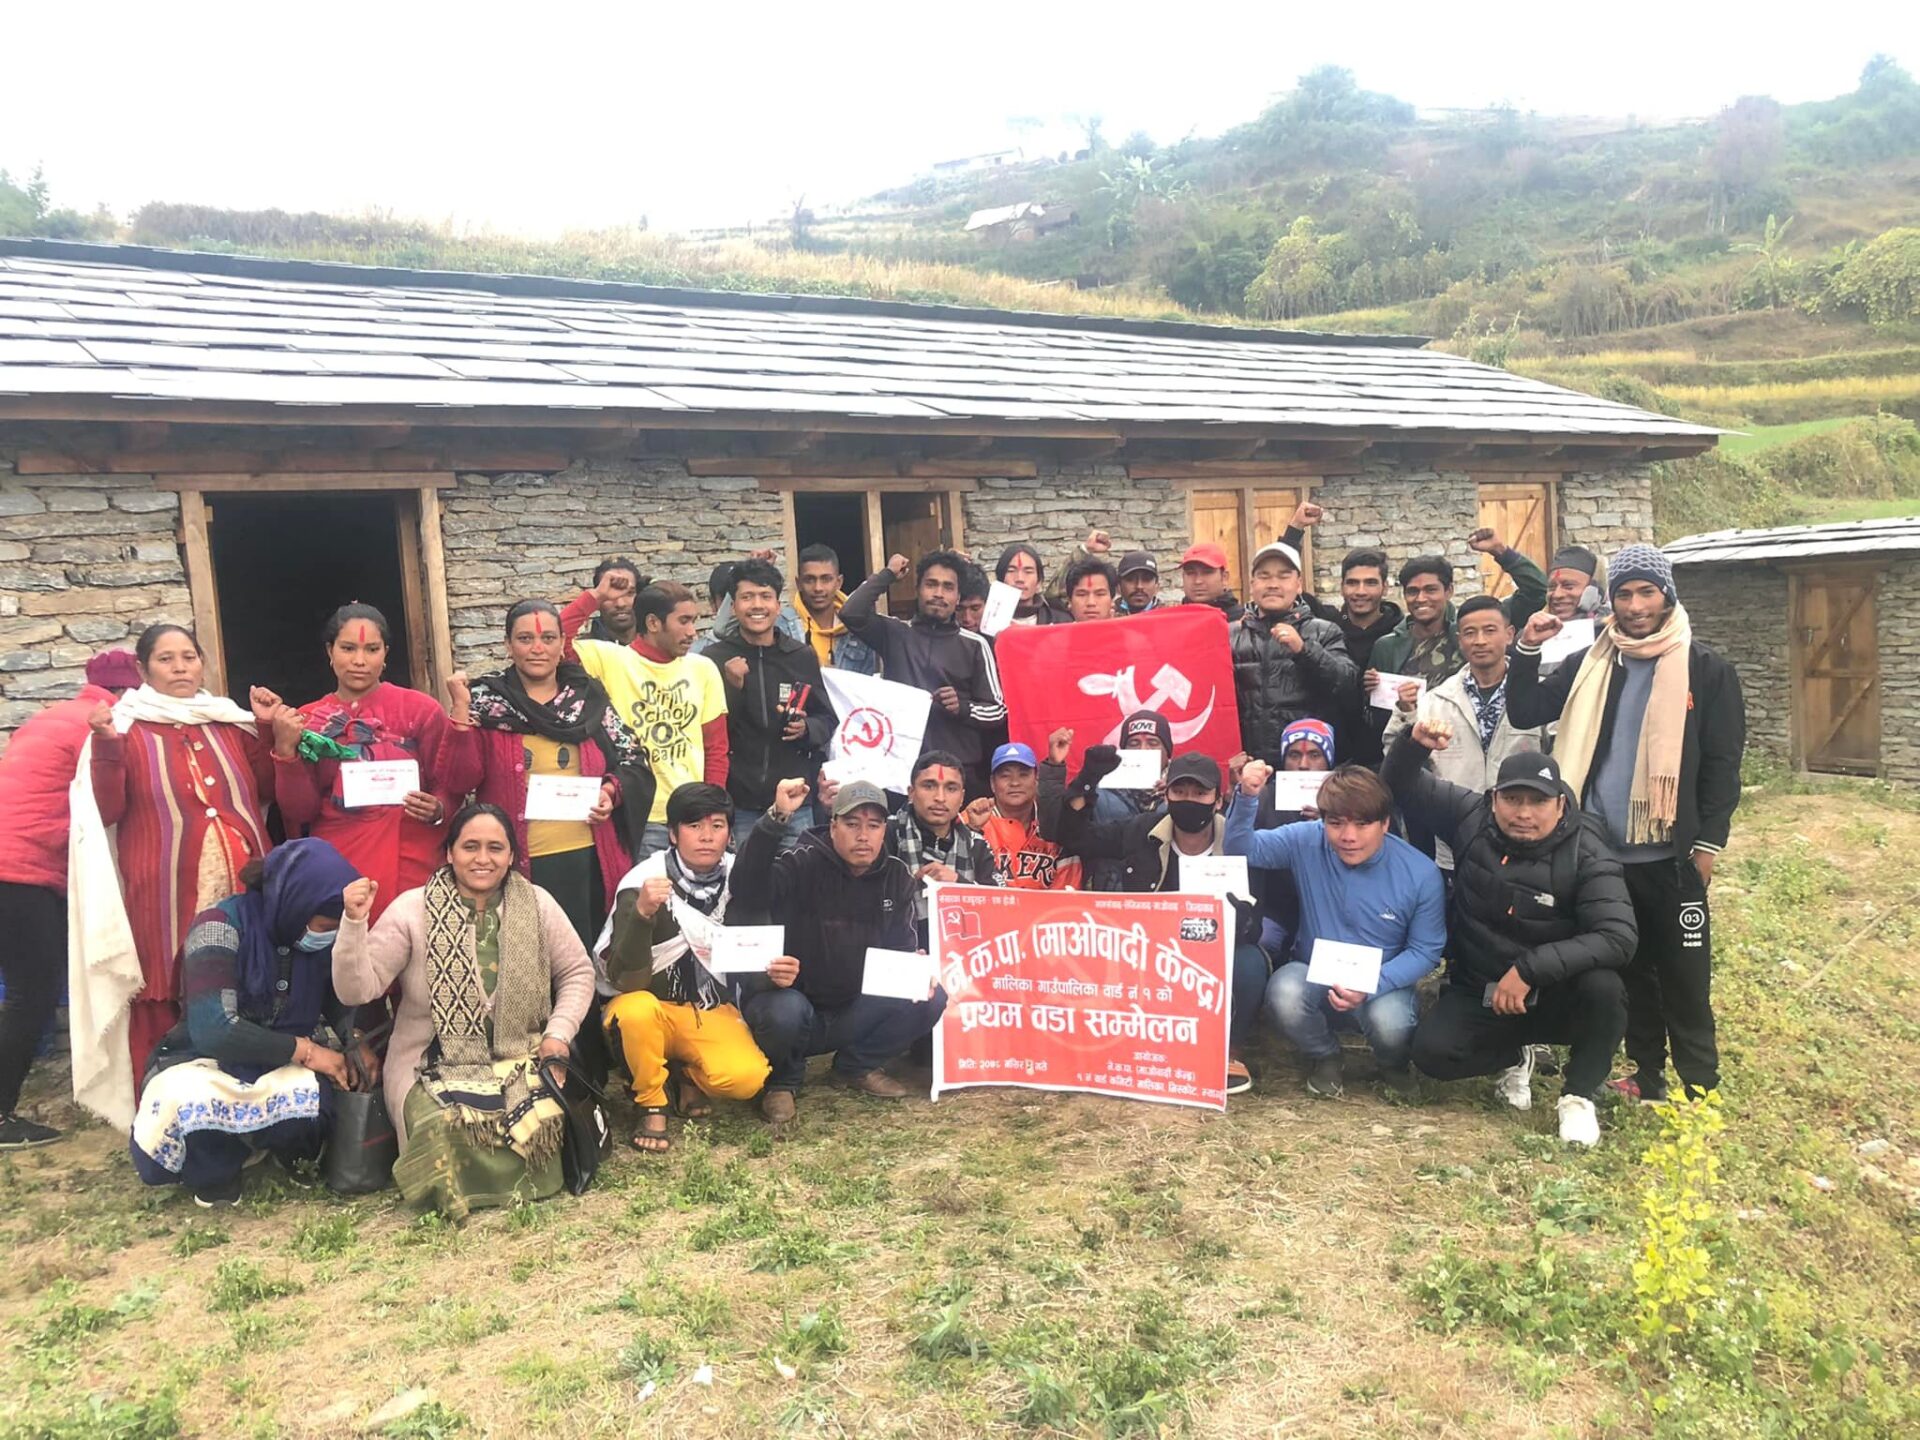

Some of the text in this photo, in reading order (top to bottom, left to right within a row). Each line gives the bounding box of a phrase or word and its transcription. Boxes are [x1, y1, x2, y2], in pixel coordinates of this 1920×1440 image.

[1684, 913, 1700, 923] 03
[1032, 911, 1150, 972] (माओवादी
[1155, 937, 1225, 1015] केन्द्र)
[992, 975, 1033, 992] मालिका
[1142, 987, 1151, 1001] १
[1156, 985, 1173, 1003] को
[959, 1001, 1199, 1046] प्रथम वडा सम्मेलन
